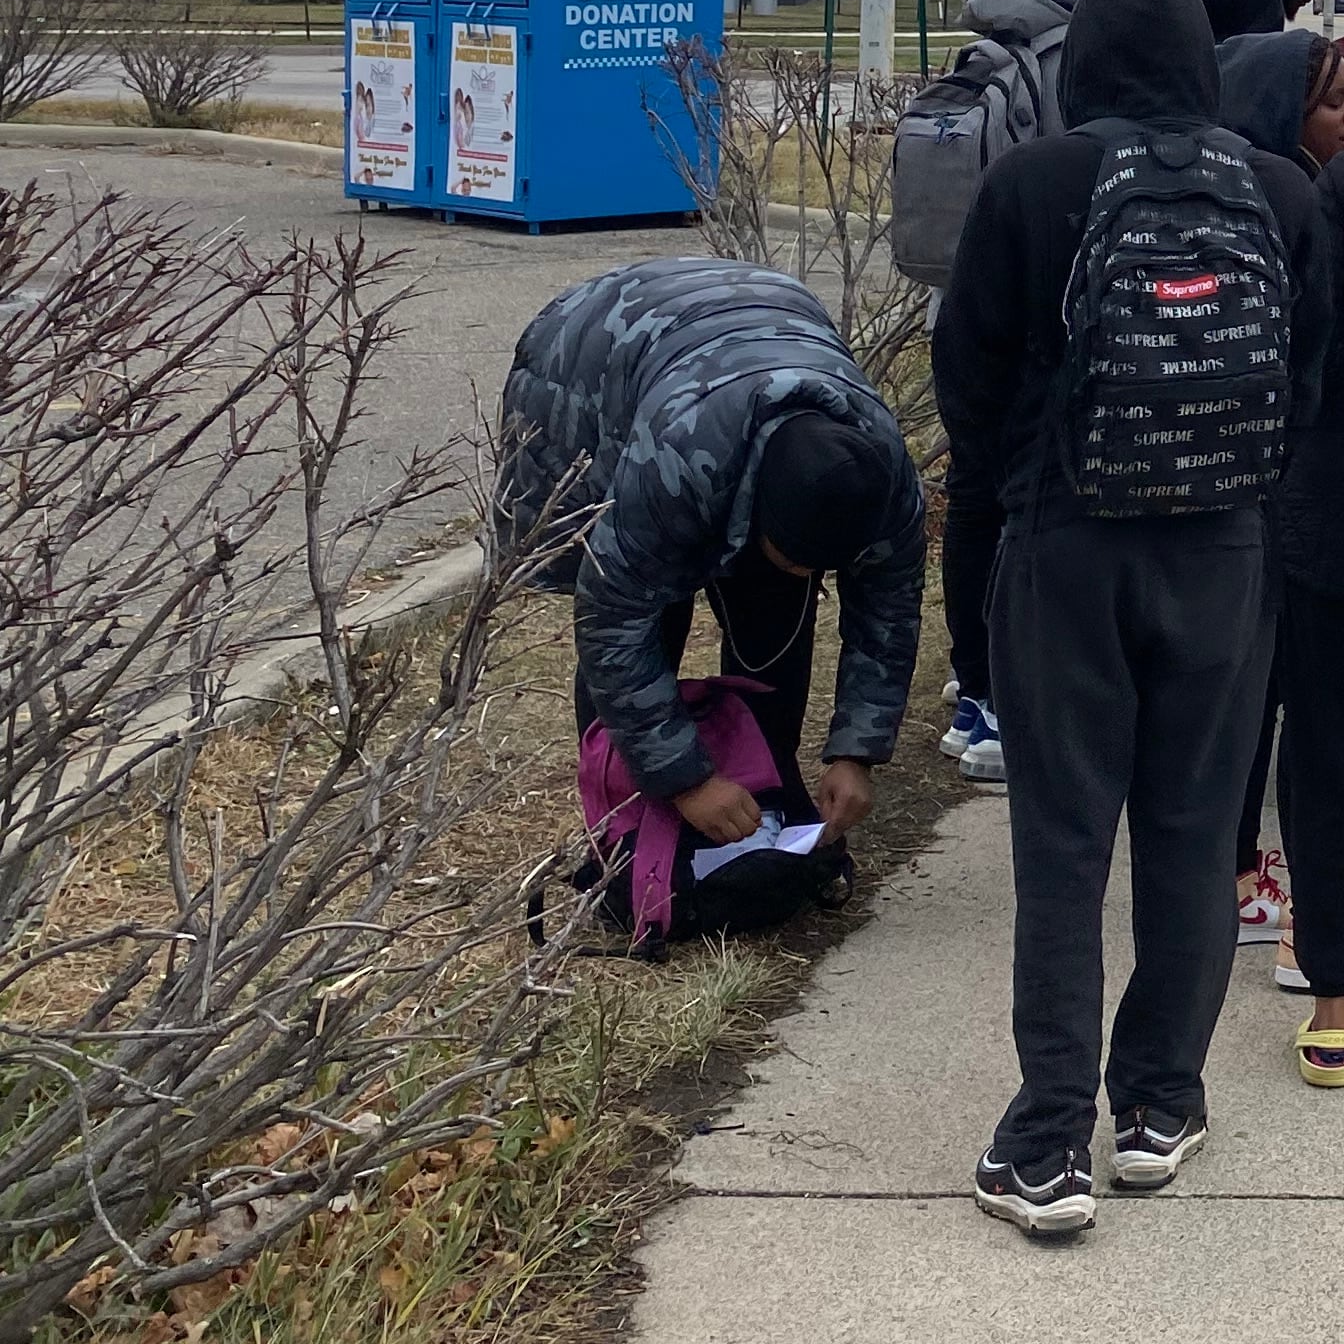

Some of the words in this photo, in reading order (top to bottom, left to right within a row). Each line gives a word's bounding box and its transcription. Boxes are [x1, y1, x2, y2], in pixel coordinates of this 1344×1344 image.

[565, 3, 694, 25] DONATION
[580, 27, 680, 50] CENTER
[1162, 279, 1214, 298] Supreme
[1154, 301, 1221, 320] SUPREME
[1113, 332, 1180, 349] SUPREME
[1159, 357, 1226, 375] SUPREME
[1175, 397, 1242, 417] SUPREME
[1133, 429, 1196, 447] SUPREME
[1173, 450, 1237, 471] SUPREME
[1127, 483, 1193, 498] SUPREME
